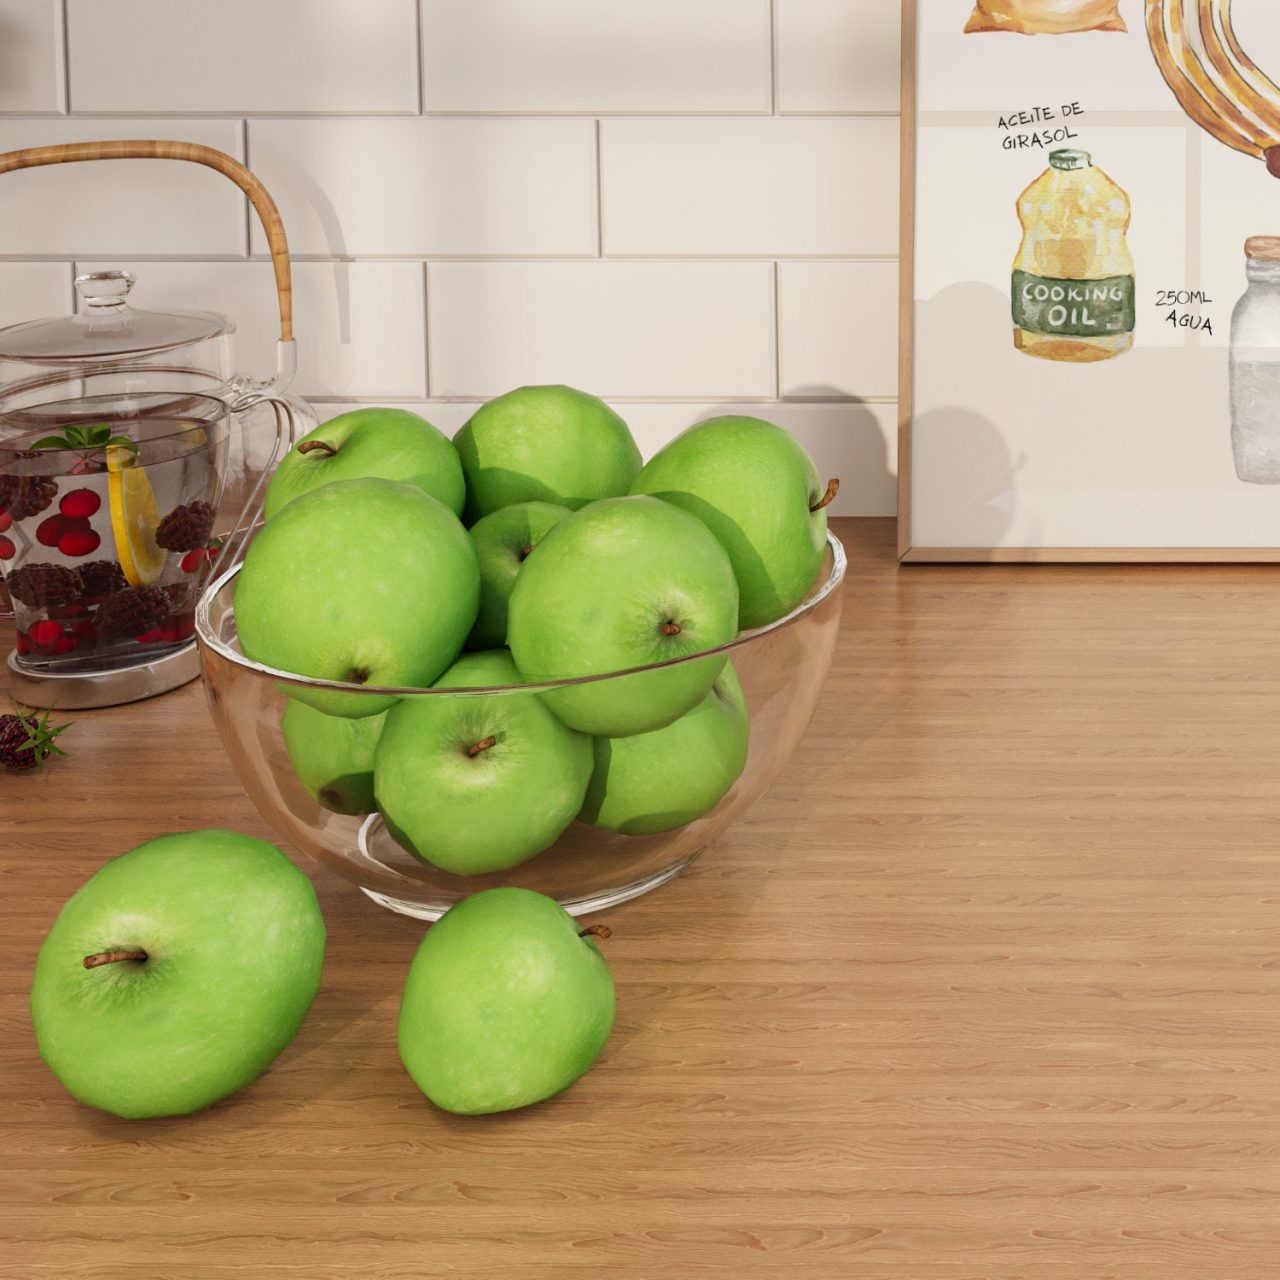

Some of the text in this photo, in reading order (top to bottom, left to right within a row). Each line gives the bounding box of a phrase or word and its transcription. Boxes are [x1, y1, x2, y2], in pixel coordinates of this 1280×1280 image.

[998, 101, 1085, 131] ACEITE DE
[1002, 125, 1079, 150] GIRASOL
[1022, 282, 1123, 302] COOKING
[1155, 290, 1213, 307] 250ML
[1047, 304, 1097, 326] OIL
[1165, 308, 1213, 337] AGUA
